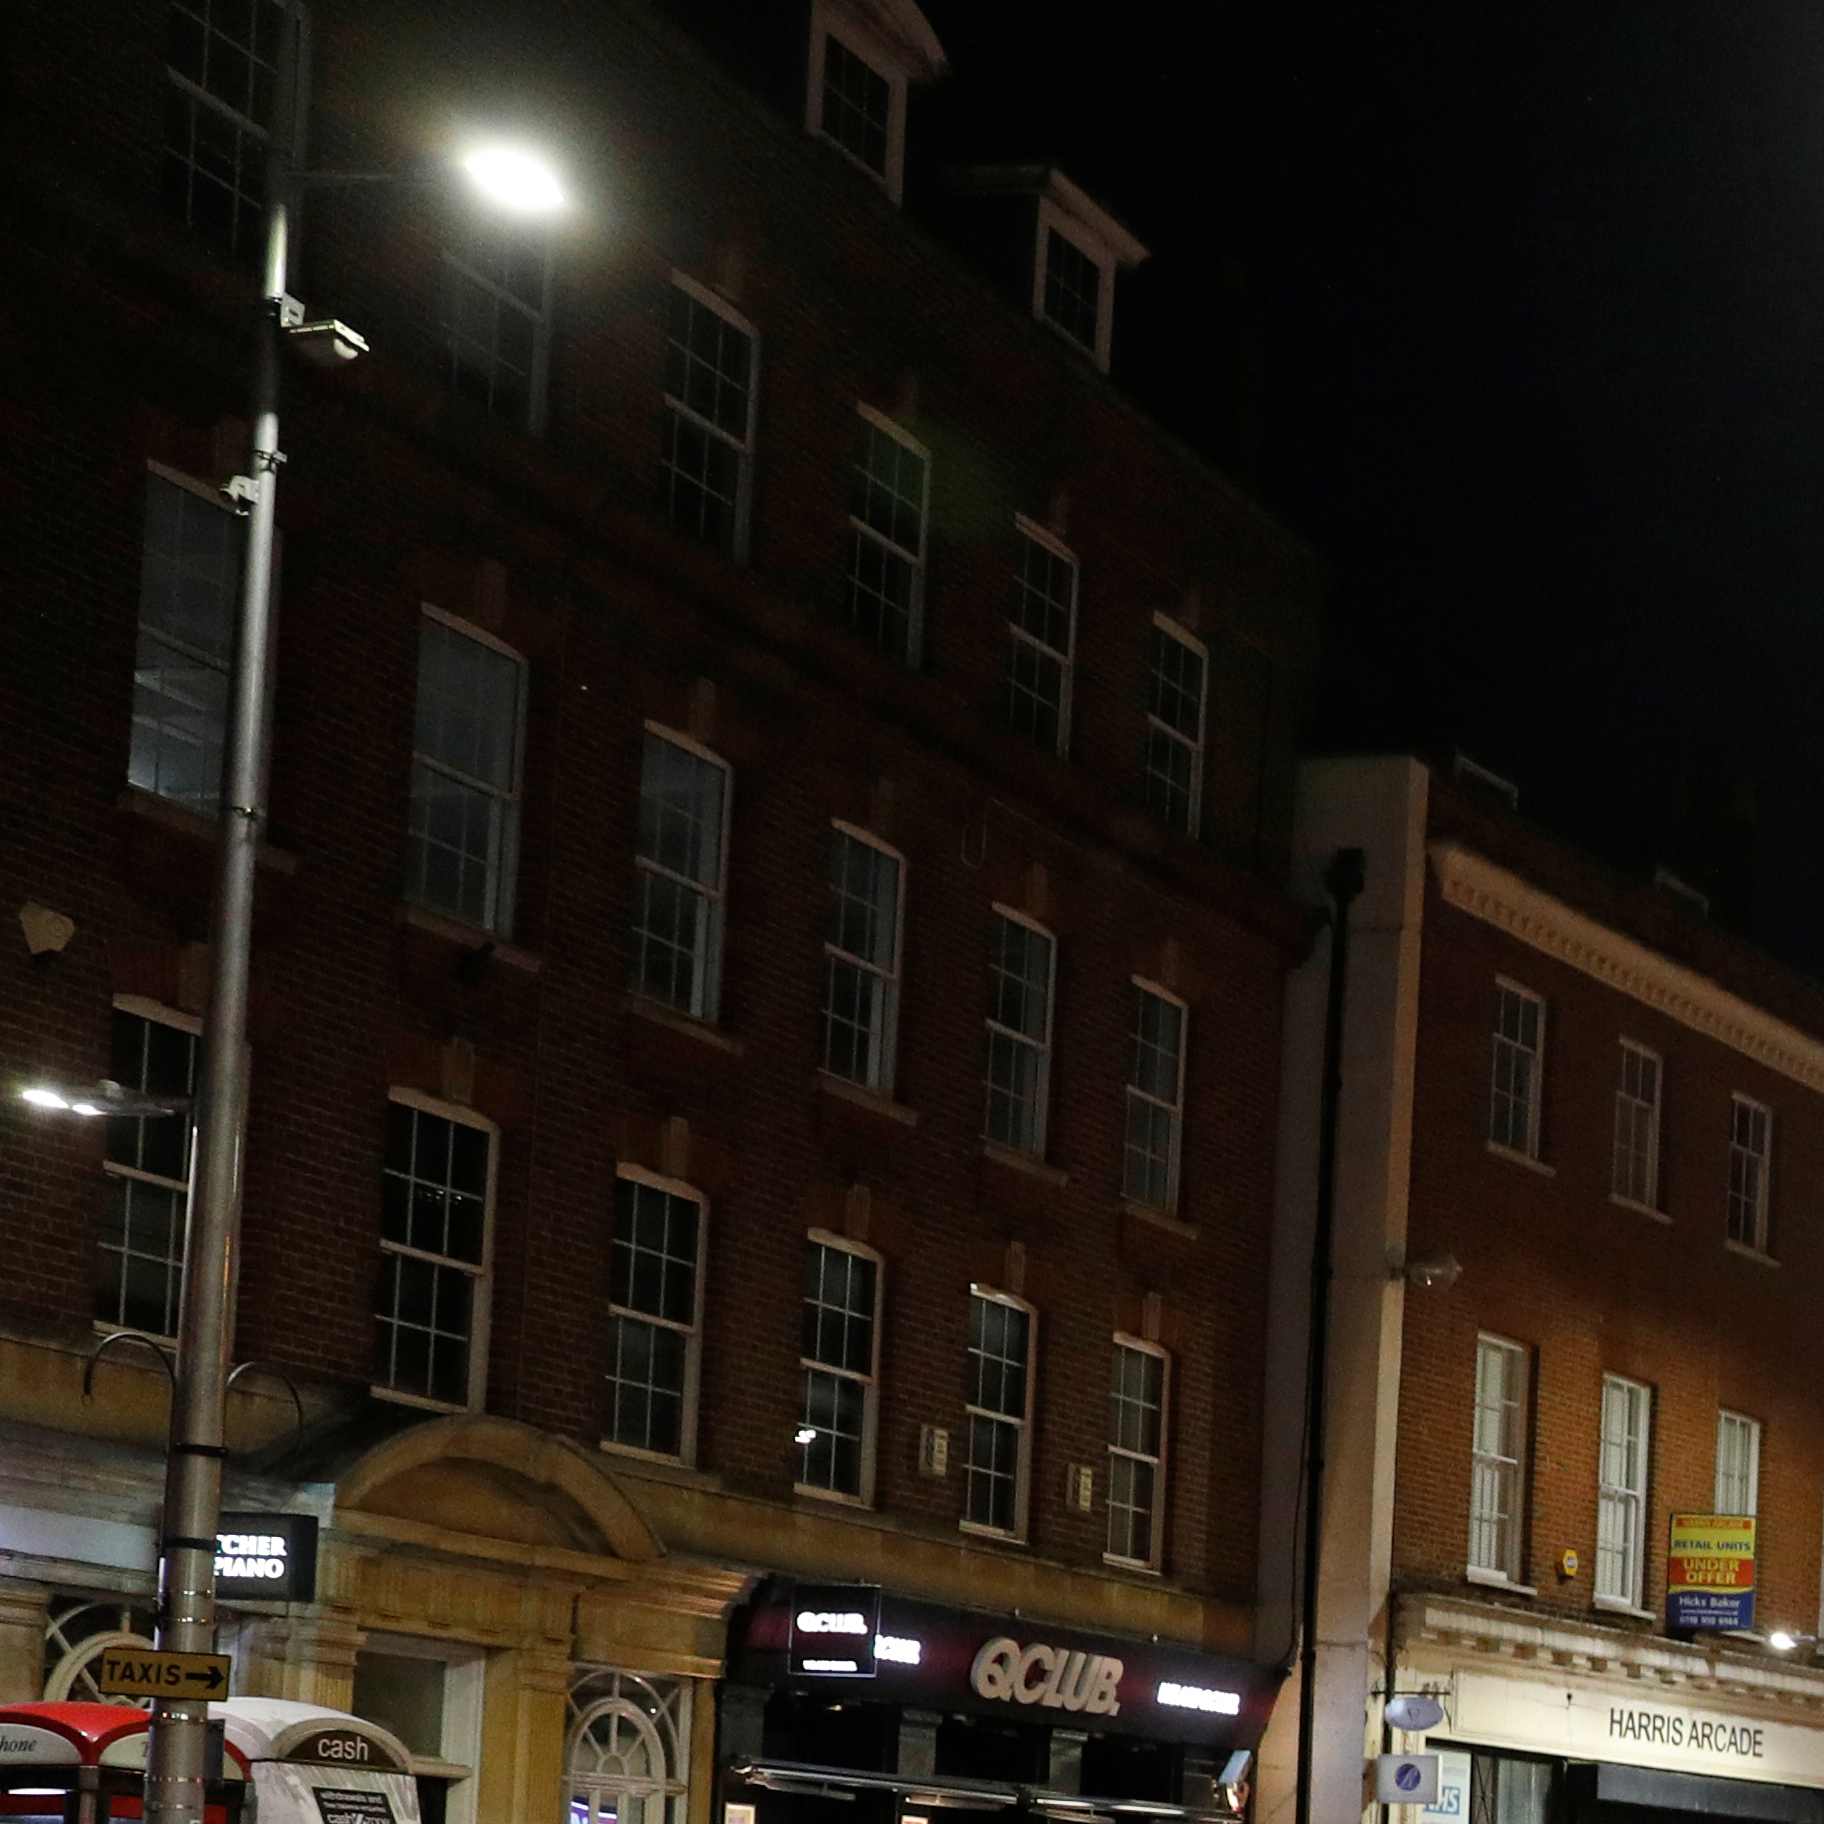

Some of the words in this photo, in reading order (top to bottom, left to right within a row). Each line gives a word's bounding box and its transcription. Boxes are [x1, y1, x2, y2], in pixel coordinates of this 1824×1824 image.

[1683, 1558, 1740, 1572] UNDER
[1685, 1570, 1736, 1584] OFFER
[107, 1659, 181, 1687] TAXIS
[1609, 1706, 1684, 1747] HARRIS
[1687, 1719, 1764, 1758] ARCADE
[318, 1736, 369, 1761] cash
